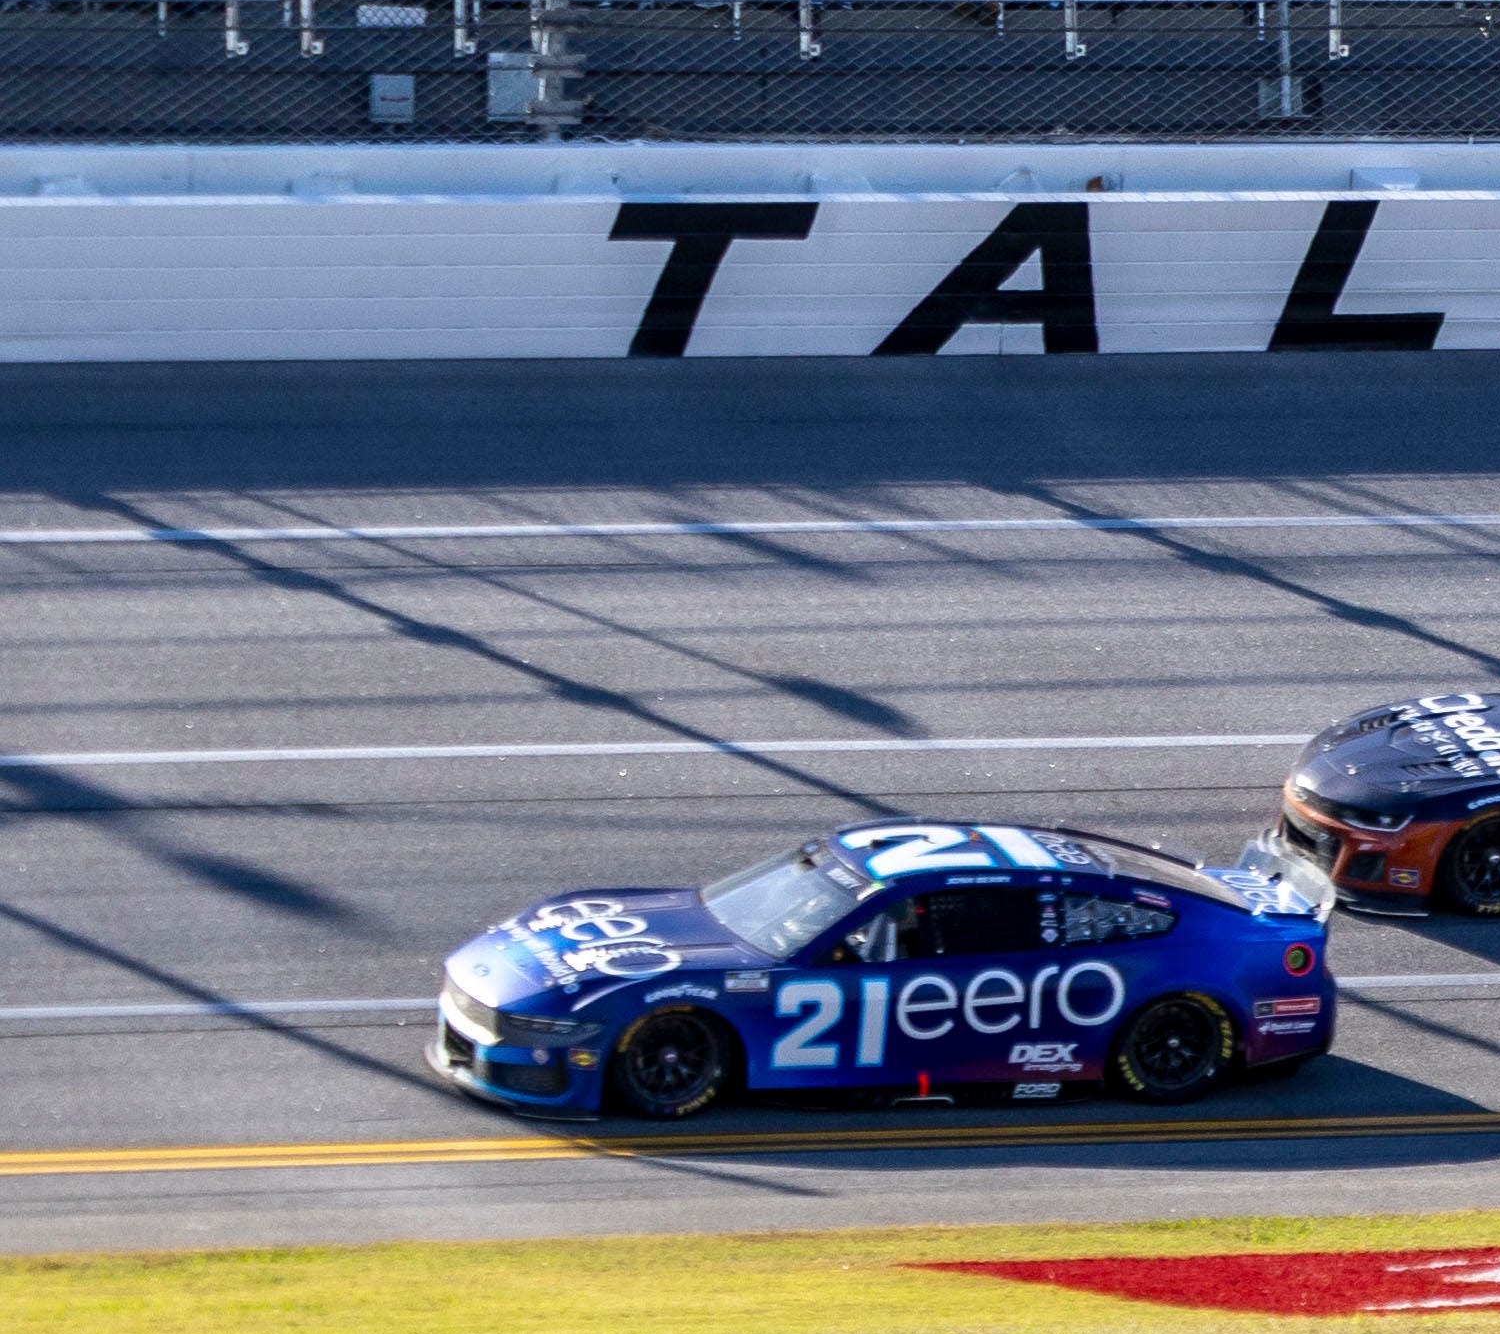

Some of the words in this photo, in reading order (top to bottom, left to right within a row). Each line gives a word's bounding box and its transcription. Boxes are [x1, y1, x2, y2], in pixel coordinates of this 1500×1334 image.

[839, 824, 1065, 881] 21
[769, 977, 890, 1069] 21
[896, 961, 1125, 1042] eero
[1007, 1042, 1080, 1065] DEX
[1014, 1082, 1062, 1094] FORD
